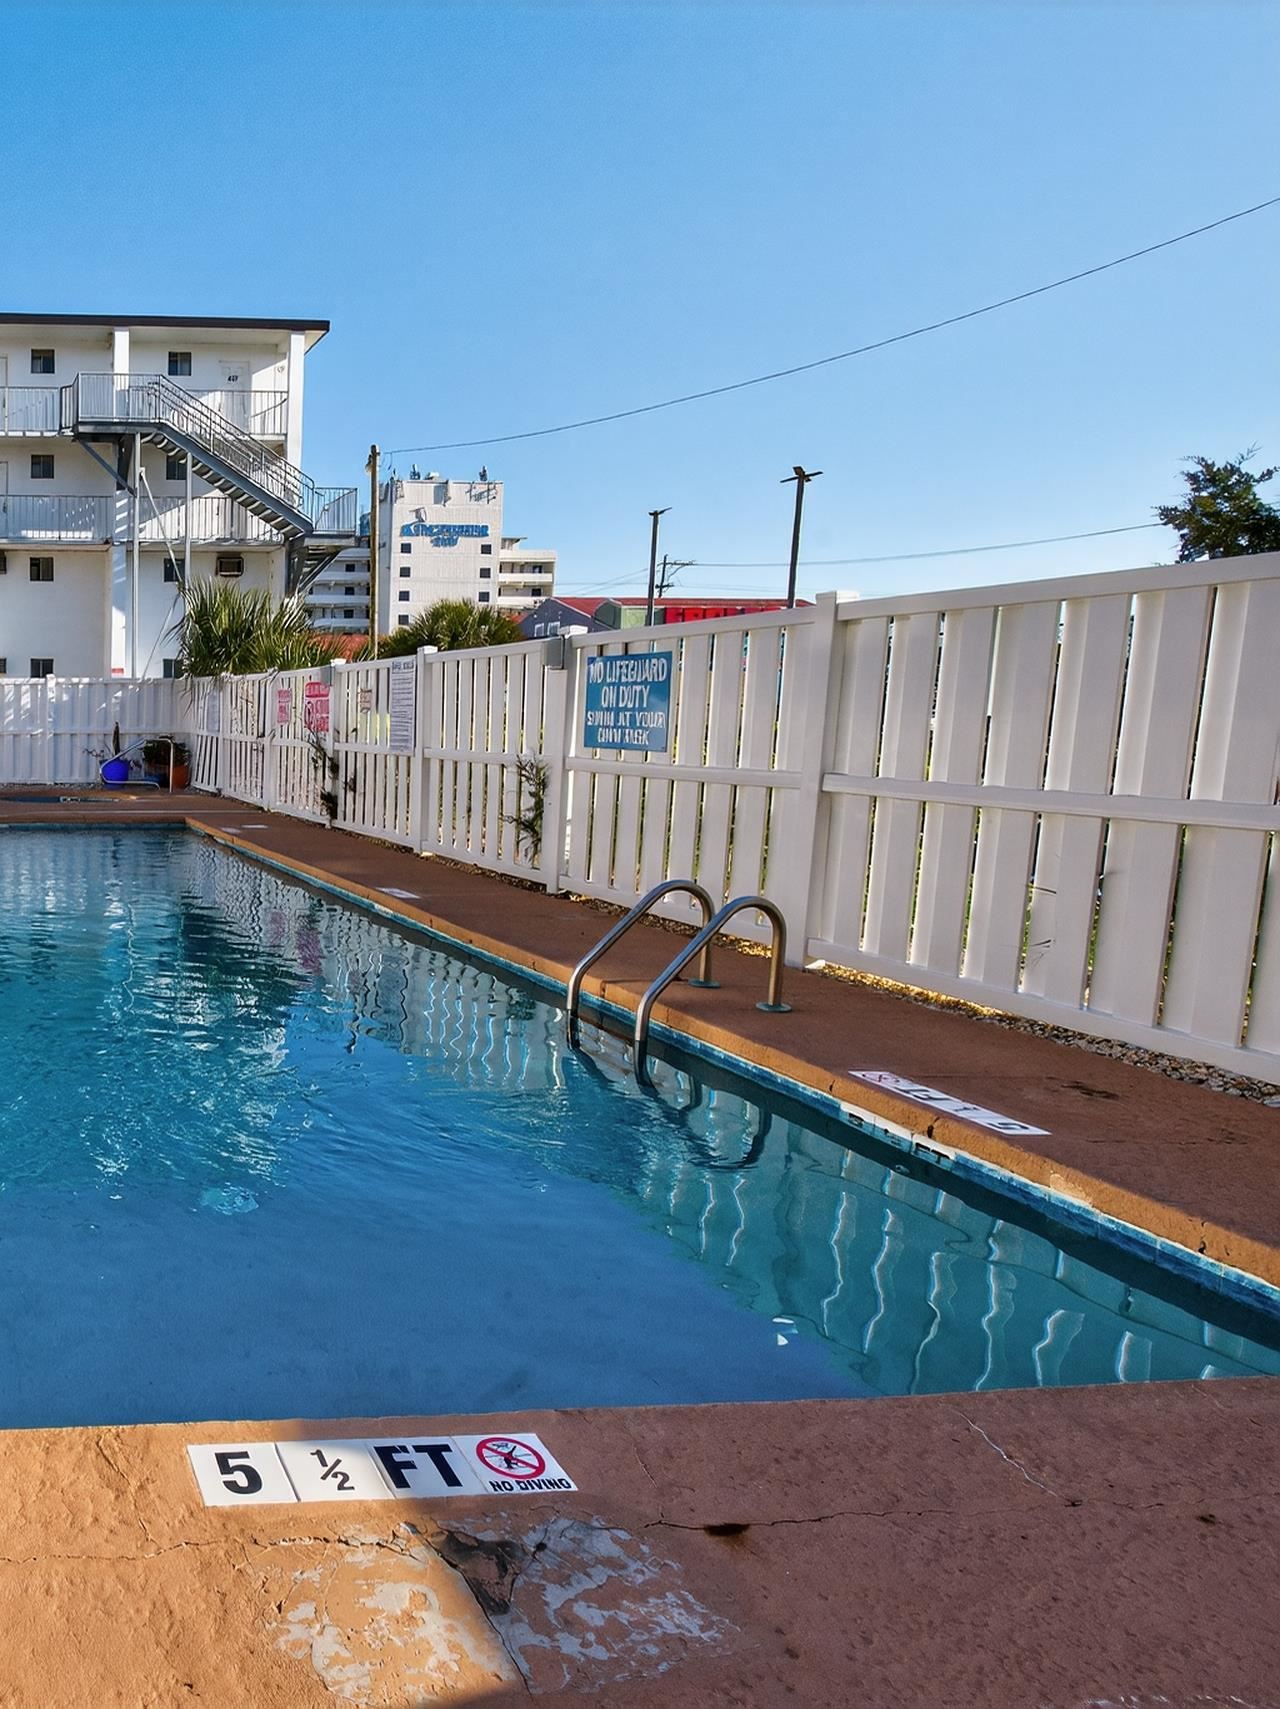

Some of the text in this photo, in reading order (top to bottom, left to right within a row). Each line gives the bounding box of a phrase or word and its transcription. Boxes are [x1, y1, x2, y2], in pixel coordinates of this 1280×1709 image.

[589, 658, 668, 683] NO LIFEGUARD
[601, 685, 650, 708] ON DUTY
[587, 710, 666, 729] SWIM AT YOUR
[597, 727, 622, 743] OWN
[214, 1450, 264, 1495] 5
[373, 1444, 463, 1488] FT
[489, 1478, 572, 1492] NO DIVING
